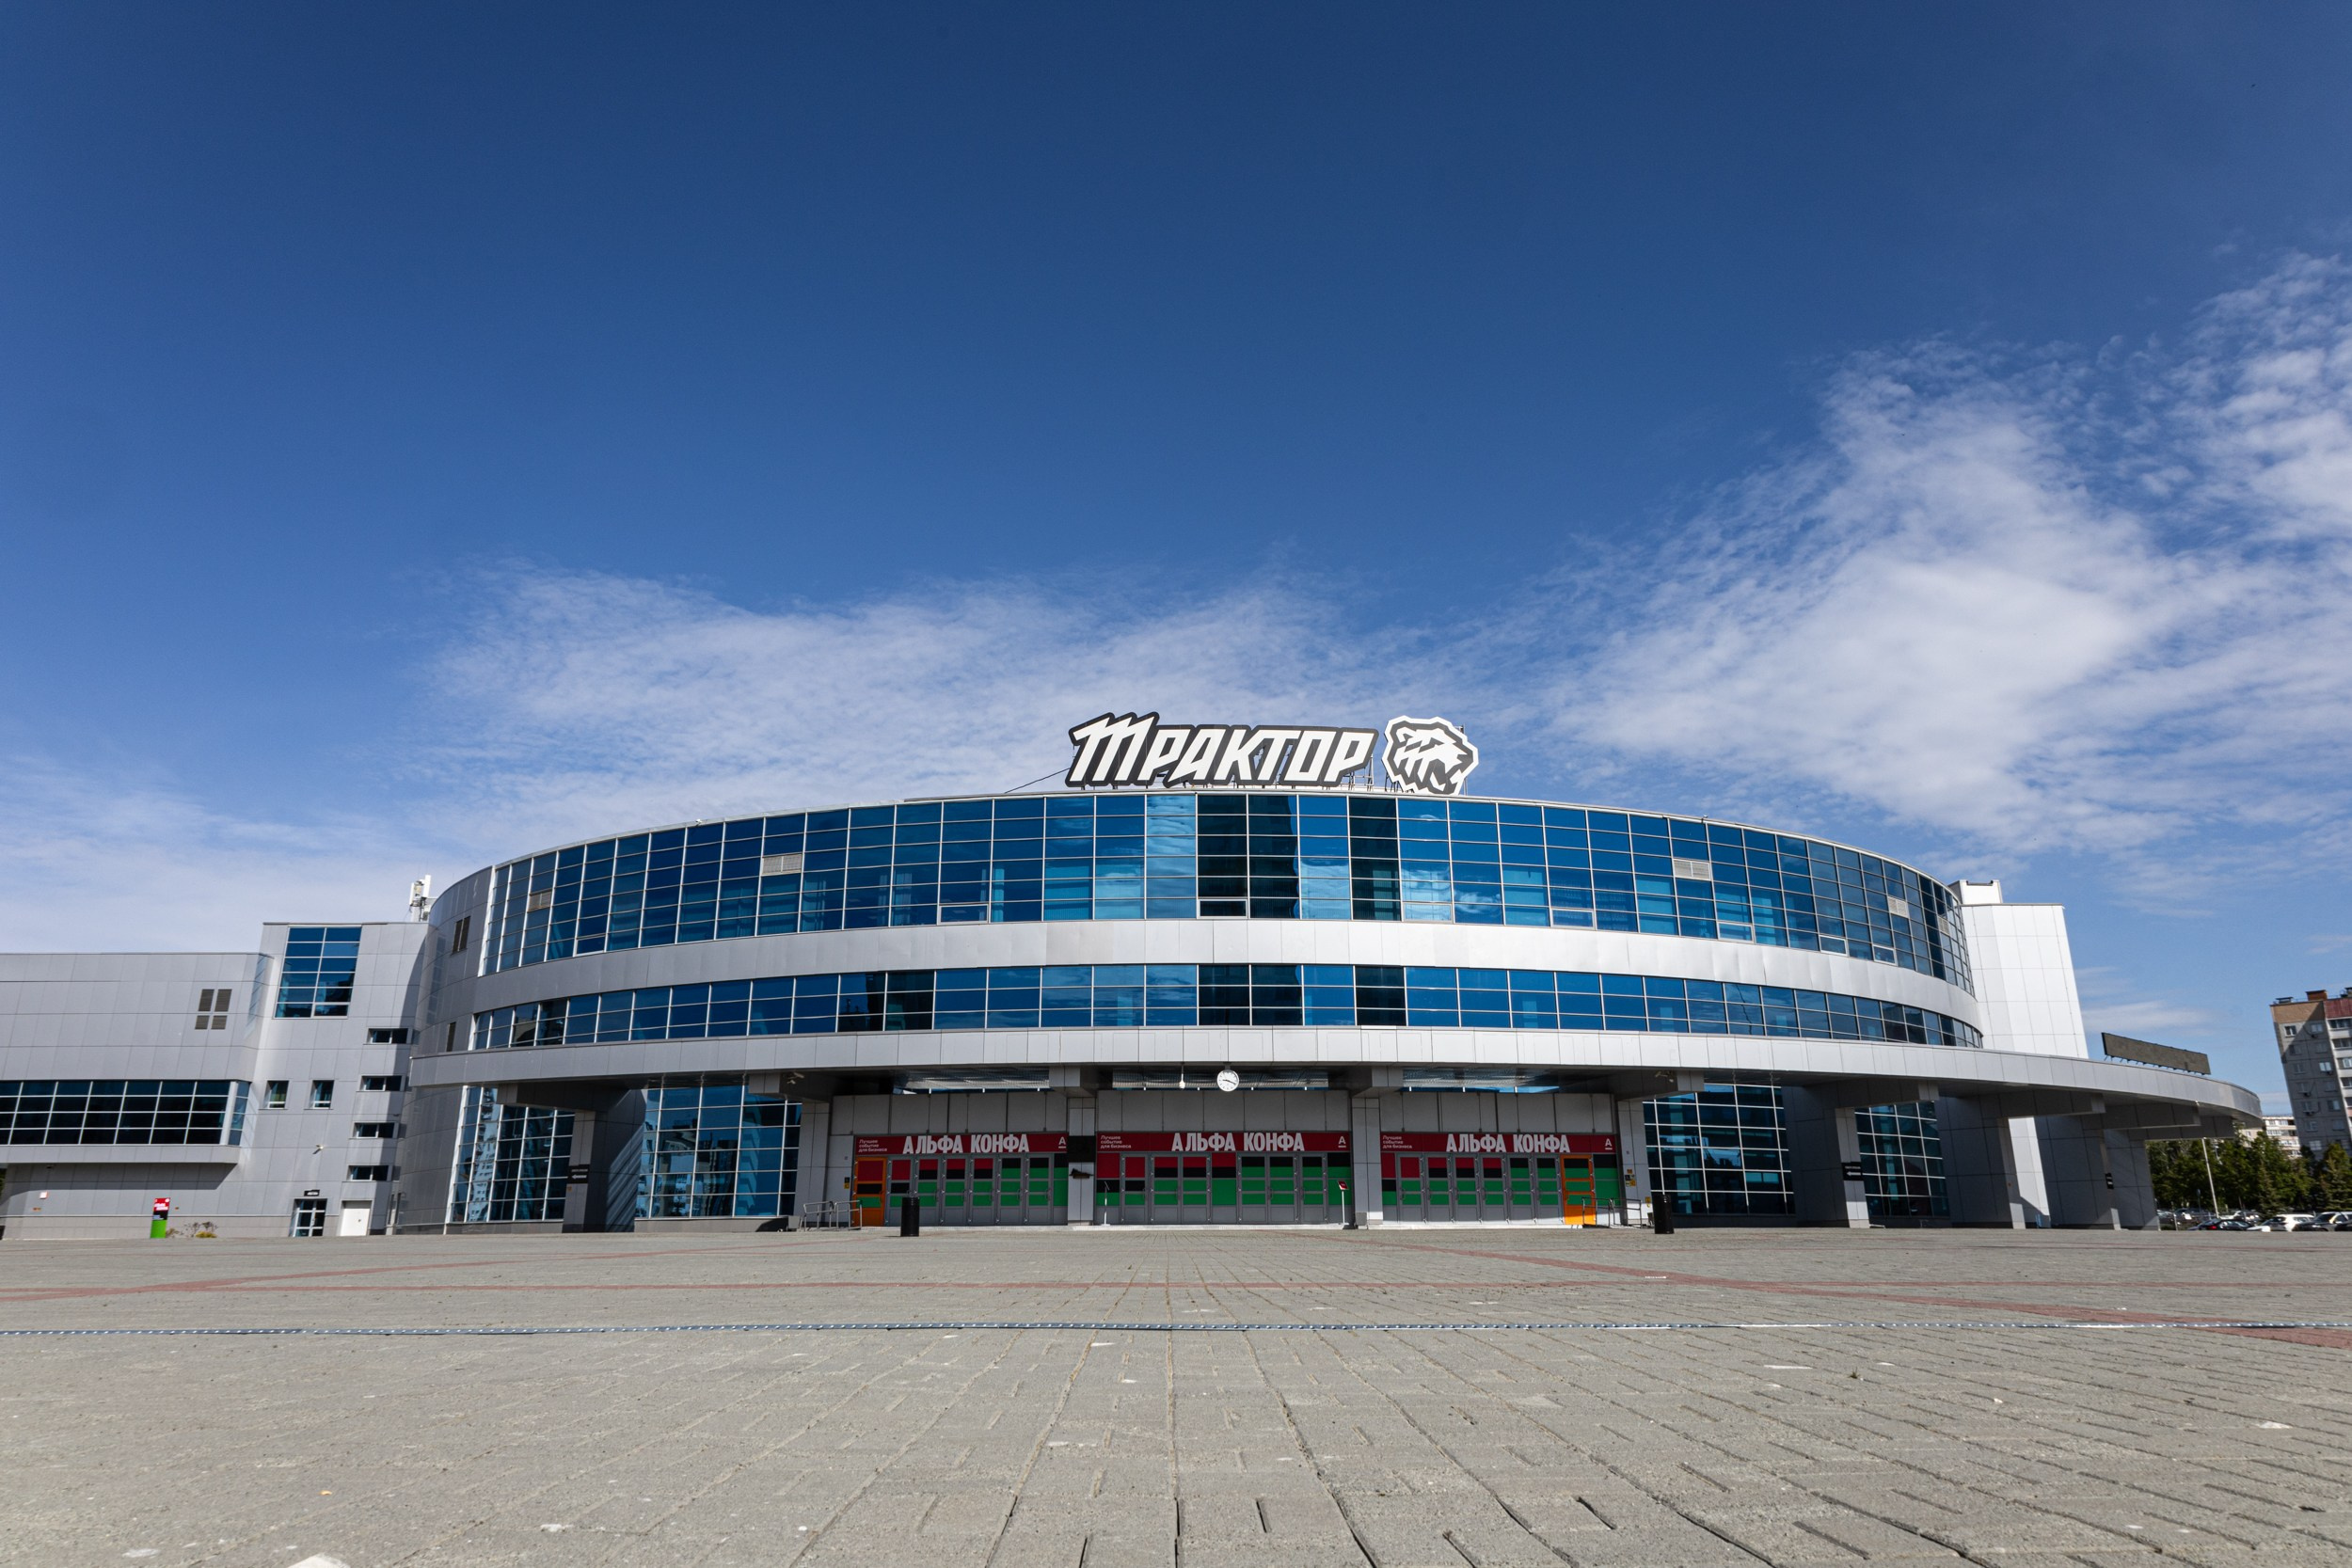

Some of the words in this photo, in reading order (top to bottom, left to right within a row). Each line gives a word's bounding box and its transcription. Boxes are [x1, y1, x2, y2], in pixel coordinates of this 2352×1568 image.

[903, 1134, 963, 1154] АЛЬФА
[970, 1133, 1029, 1153] КОНФА
[1171, 1132, 1236, 1152] АЛЬФА
[1244, 1132, 1305, 1151] КОНФА
[1446, 1133, 1507, 1152] АЛЬФА
[1513, 1133, 1570, 1153] КОНФА
